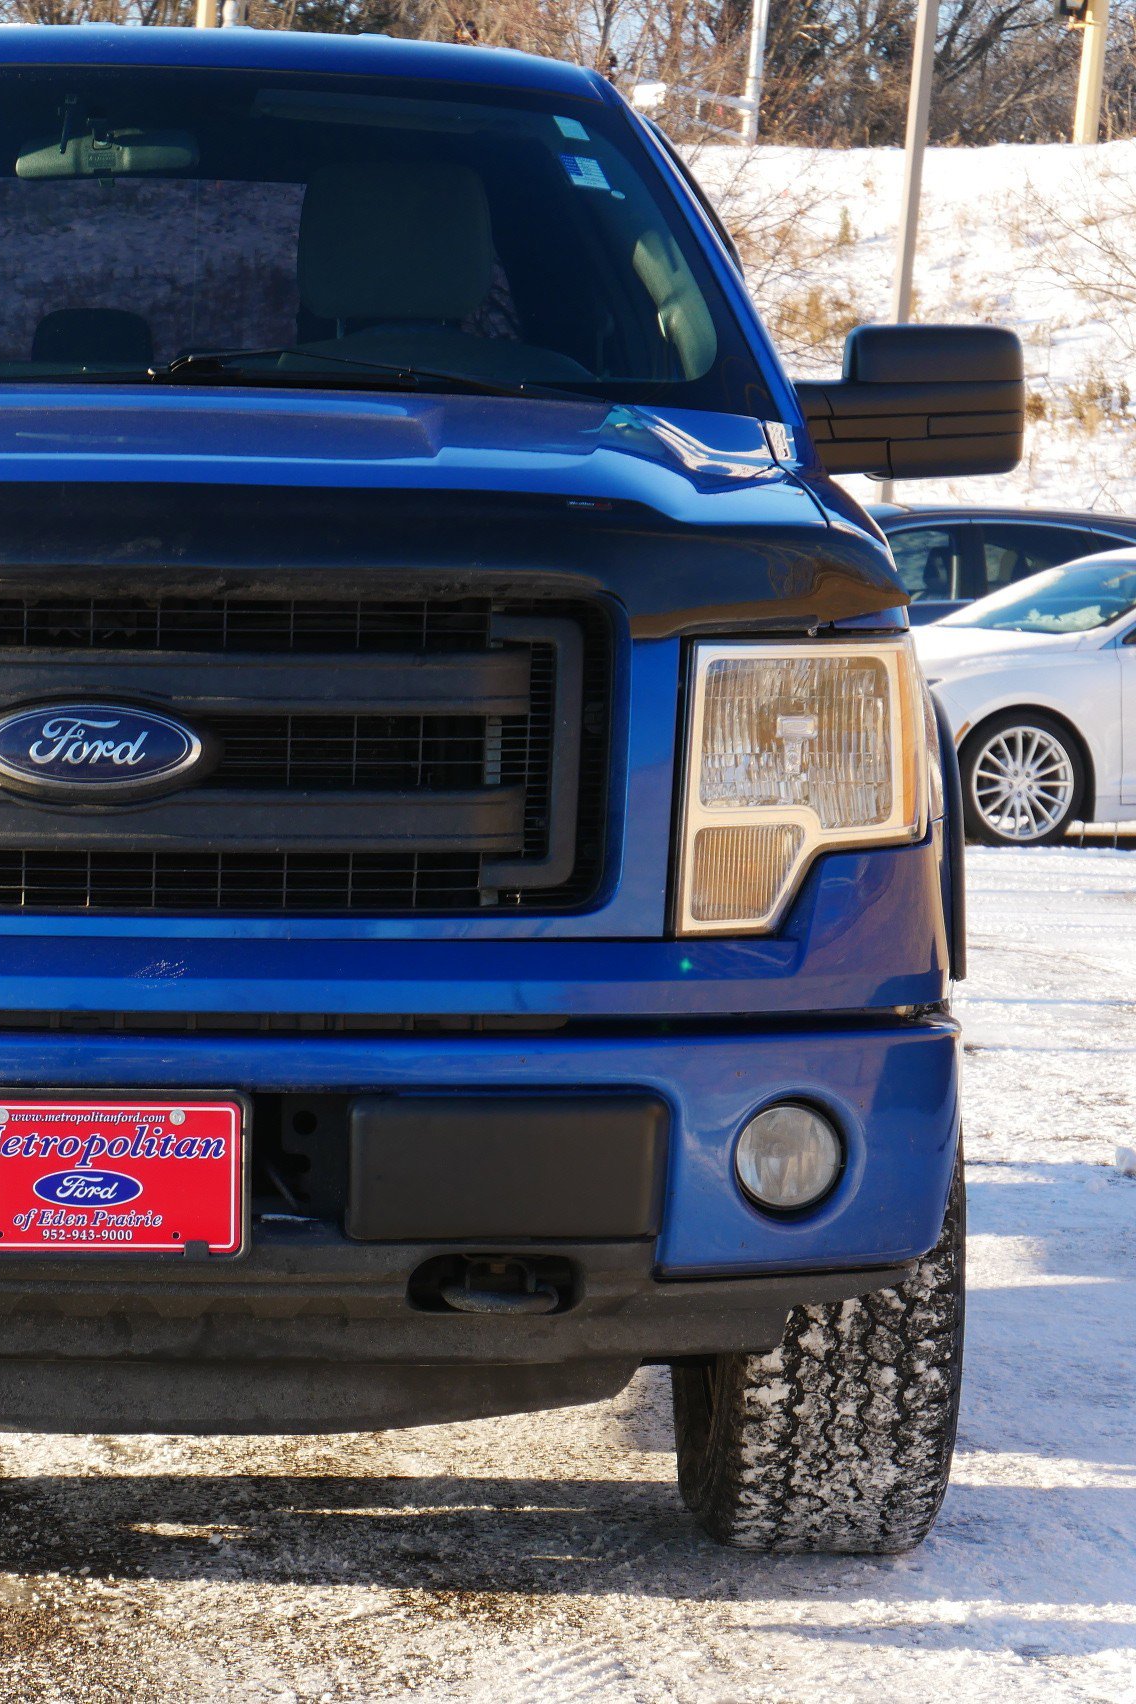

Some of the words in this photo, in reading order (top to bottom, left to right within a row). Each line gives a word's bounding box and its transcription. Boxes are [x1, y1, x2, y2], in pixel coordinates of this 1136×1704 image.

[29, 717, 149, 766] Ford
[10, 1111, 166, 1125] www.metropolitanford.com
[56, 1175, 119, 1200] Ford
[13, 1210, 36, 1231] of
[37, 1210, 87, 1227] Eden
[91, 1210, 163, 1228] Prairie
[42, 1229, 133, 1242] 952-943-9000
